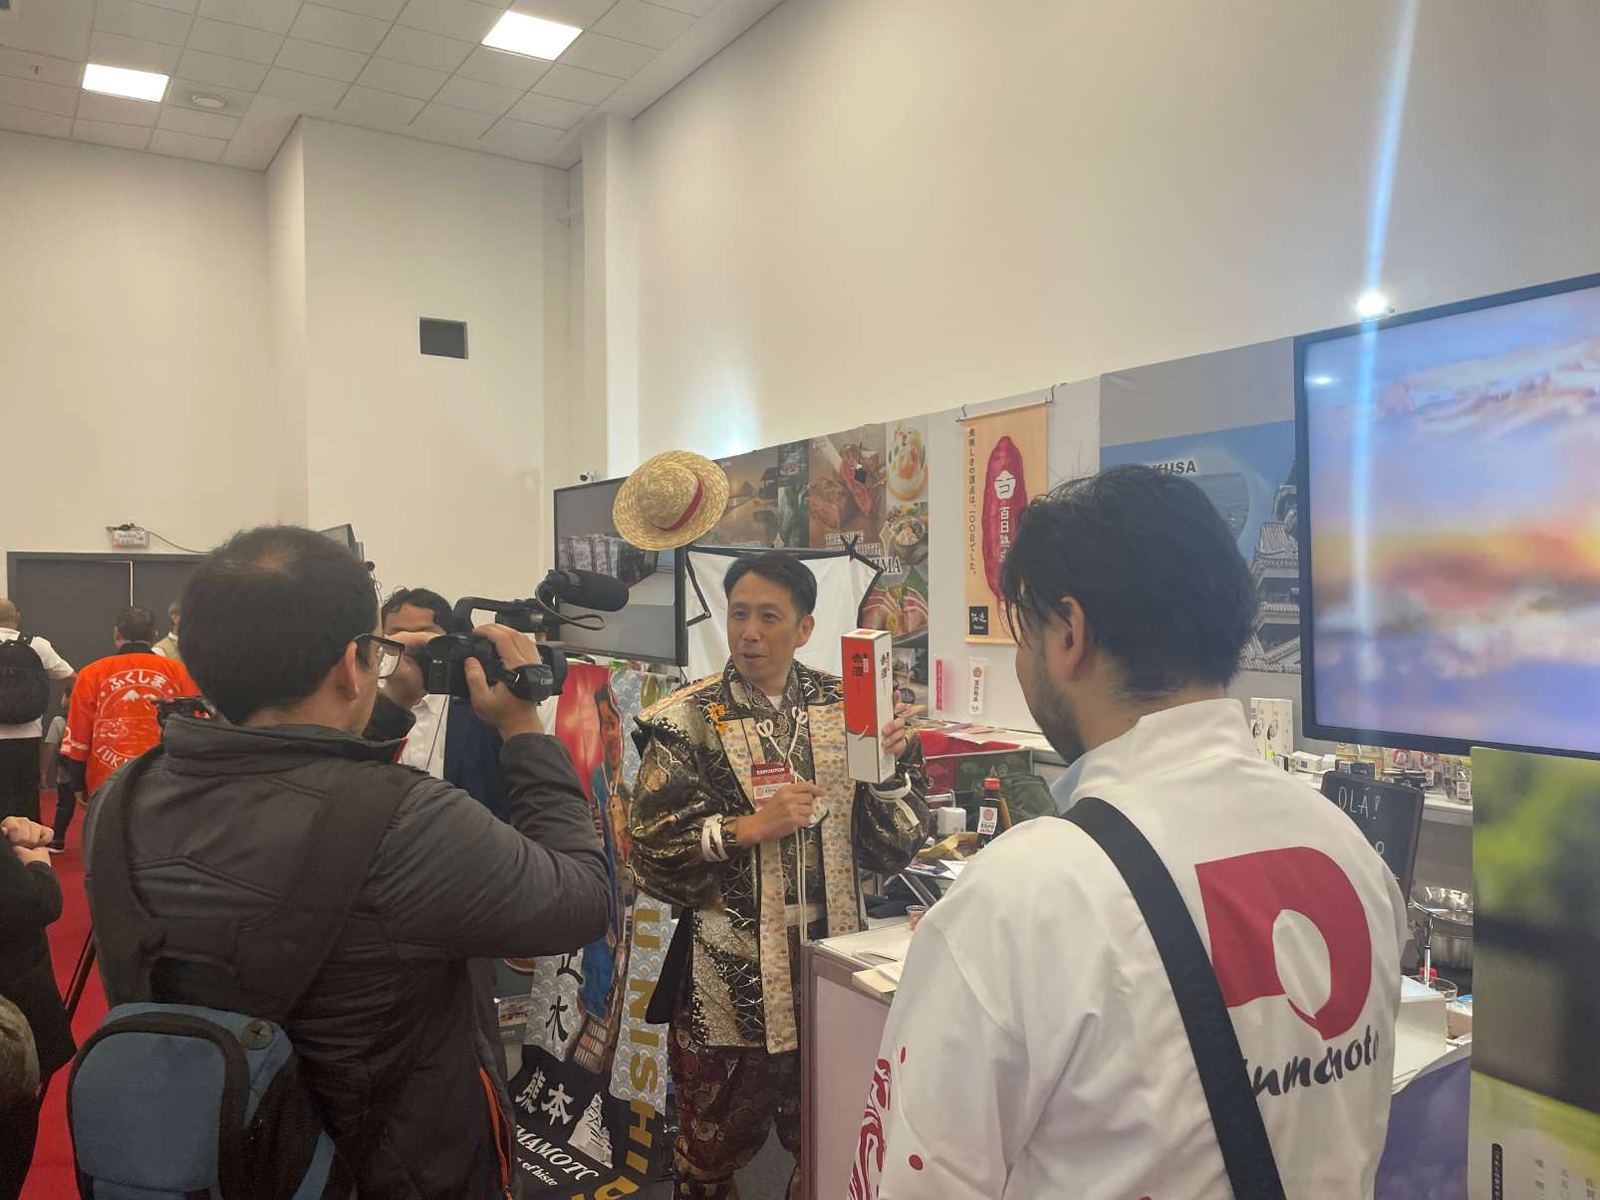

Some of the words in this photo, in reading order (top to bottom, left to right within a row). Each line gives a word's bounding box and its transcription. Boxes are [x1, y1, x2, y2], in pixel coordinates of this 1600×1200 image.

[109, 671, 167, 692] ふくしま
[515, 1065, 574, 1126] 熊本
